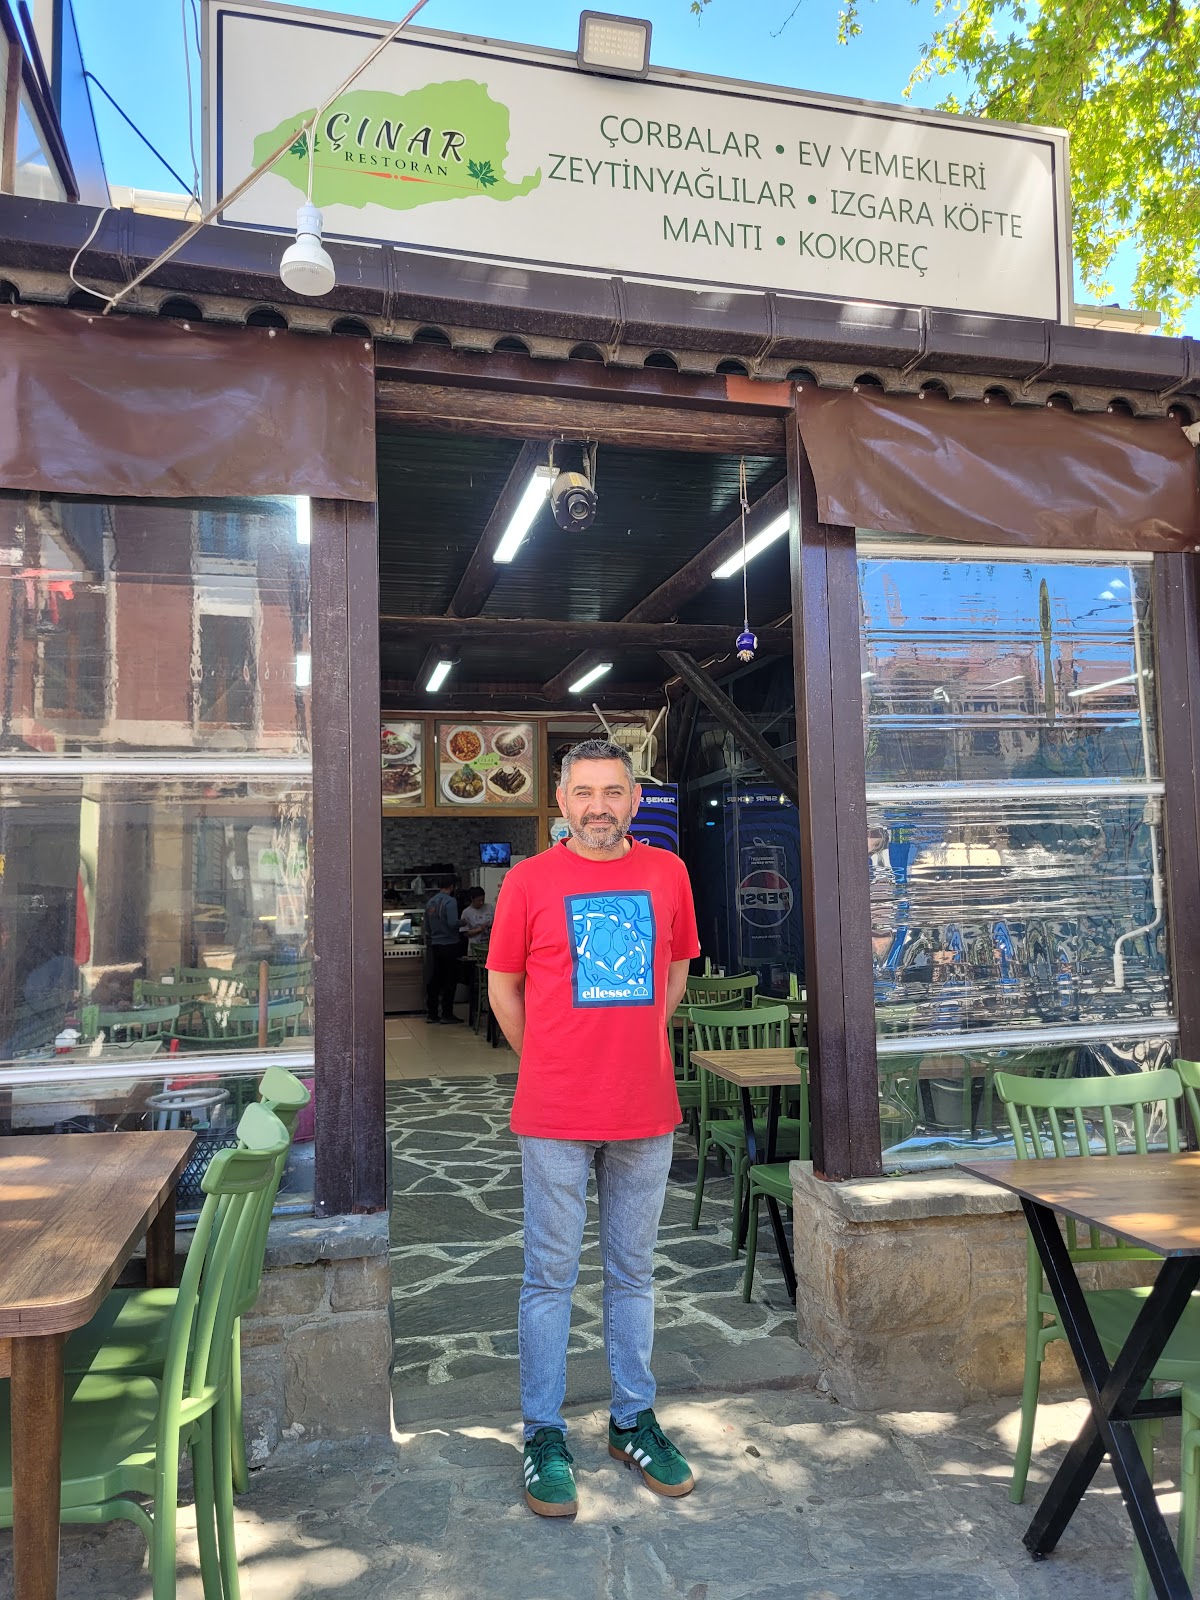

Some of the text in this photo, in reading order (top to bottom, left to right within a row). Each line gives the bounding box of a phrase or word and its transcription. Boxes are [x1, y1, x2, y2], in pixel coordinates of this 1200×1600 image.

[325, 112, 465, 162] ÇINAR
[344, 151, 449, 176] RESTORAN
[600, 115, 987, 190] ÇORBALAR EV YEMEKLERİ
[547, 153, 1023, 239] ZEYTİNYAĞLILAR IZGARA KÖFTE
[663, 215, 928, 278] MANTI KOKOREÇ
[582, 986, 631, 999] ellesse
